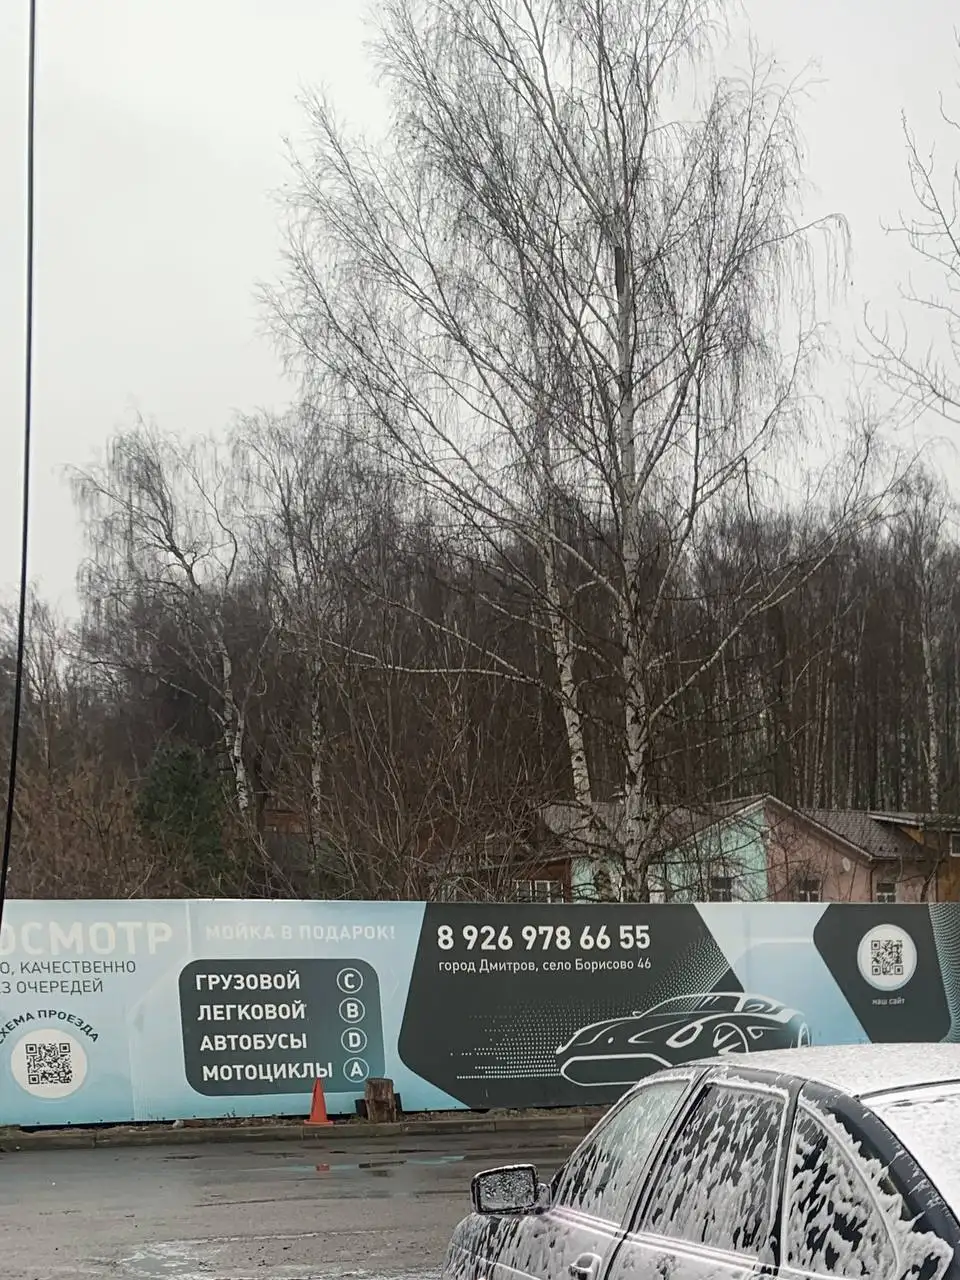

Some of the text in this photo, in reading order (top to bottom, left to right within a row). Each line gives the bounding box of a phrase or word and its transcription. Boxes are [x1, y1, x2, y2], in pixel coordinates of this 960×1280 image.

[205, 923, 396, 943] МОЙКА В ПОДАРОК!
[437, 925, 651, 950] 8 926 978 66 55
[20, 960, 137, 975] КАЧЕСТВЕННО
[439, 958, 652, 974] город Дмитров, село Борисово 46
[16, 977, 104, 996] ОЧЕРЕДЕЙ
[196, 970, 300, 990] ГРУЗОВОЙ
[197, 1000, 305, 1021] ЛЕГКОВОЙ
[37, 1009, 99, 1042] ПРОЕЗДА
[200, 1033, 361, 1051] АВТОБУСЫ D
[202, 1062, 332, 1082] МОТОЦИКЛЫ
